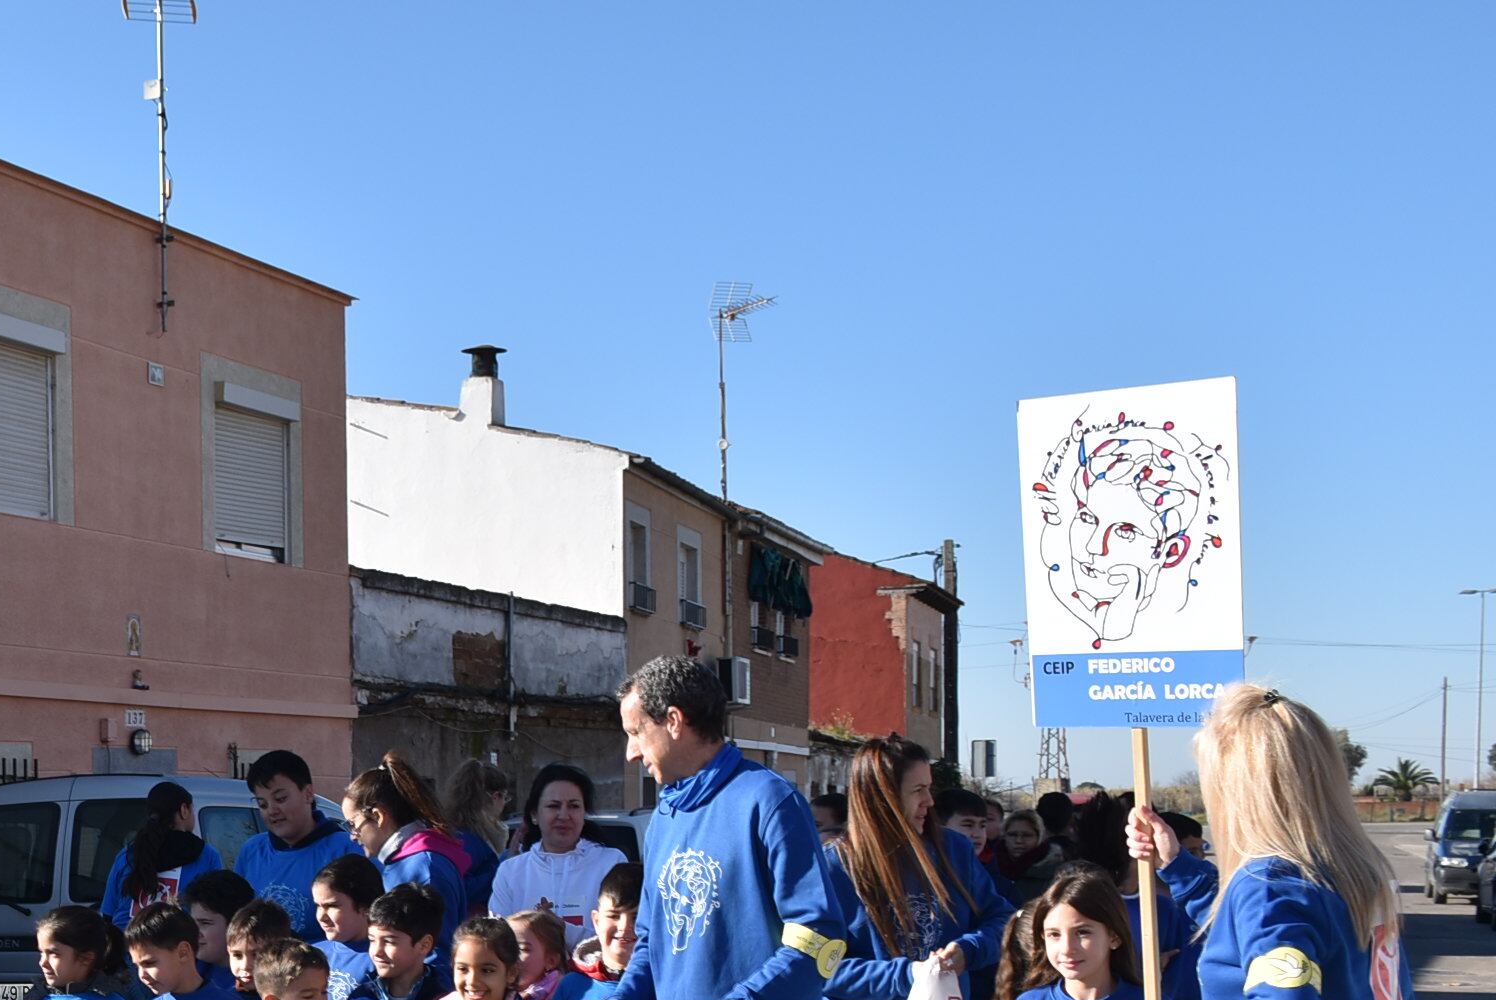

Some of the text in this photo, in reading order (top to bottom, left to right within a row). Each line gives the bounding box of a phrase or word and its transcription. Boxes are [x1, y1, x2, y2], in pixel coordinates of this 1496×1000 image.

[1043, 657, 1175, 675] CEIP FEDERICO
[1088, 681, 1226, 701] GARCÍA LORCA
[127, 711, 143, 725] 137
[1124, 712, 1174, 723] Talavera
[1177, 711, 1191, 723] de
